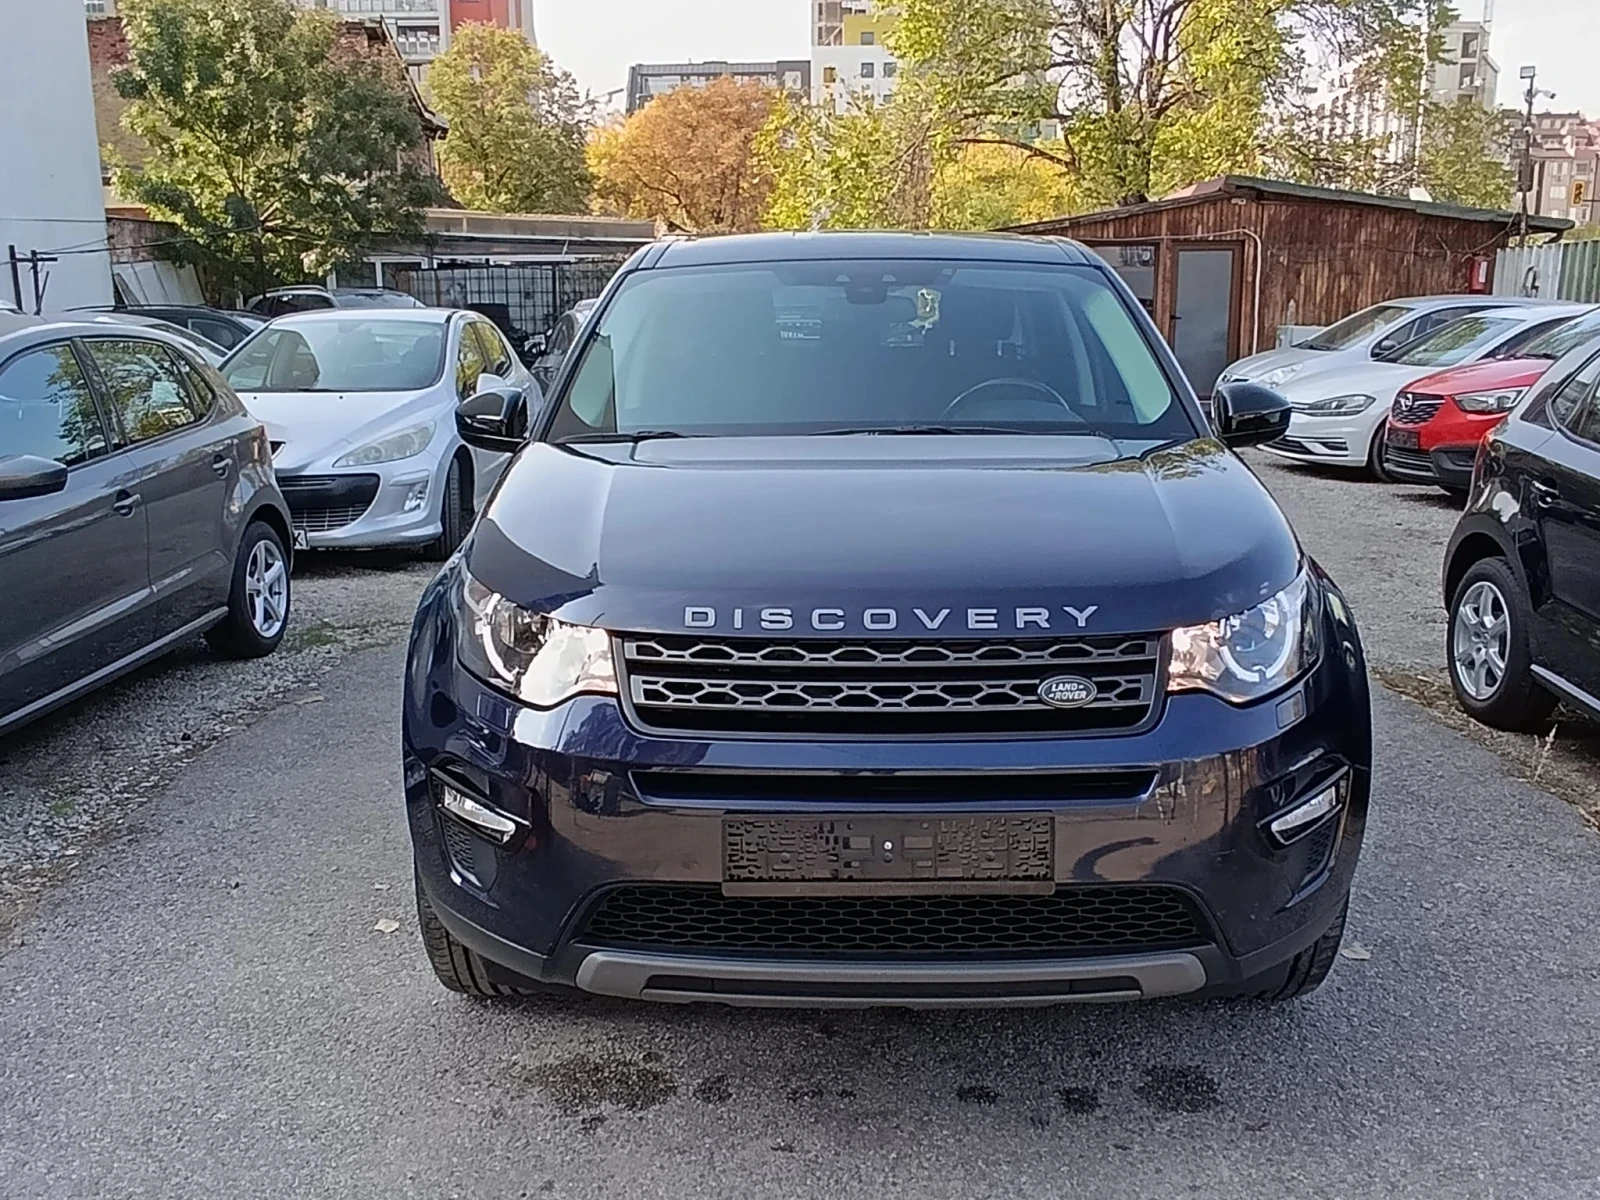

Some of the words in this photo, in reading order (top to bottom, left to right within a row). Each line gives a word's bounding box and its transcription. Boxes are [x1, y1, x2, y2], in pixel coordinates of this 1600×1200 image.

[684, 605, 1099, 630] DISCOVERY
[1051, 682, 1079, 692] LAND
[1053, 690, 1088, 701] ROVER
